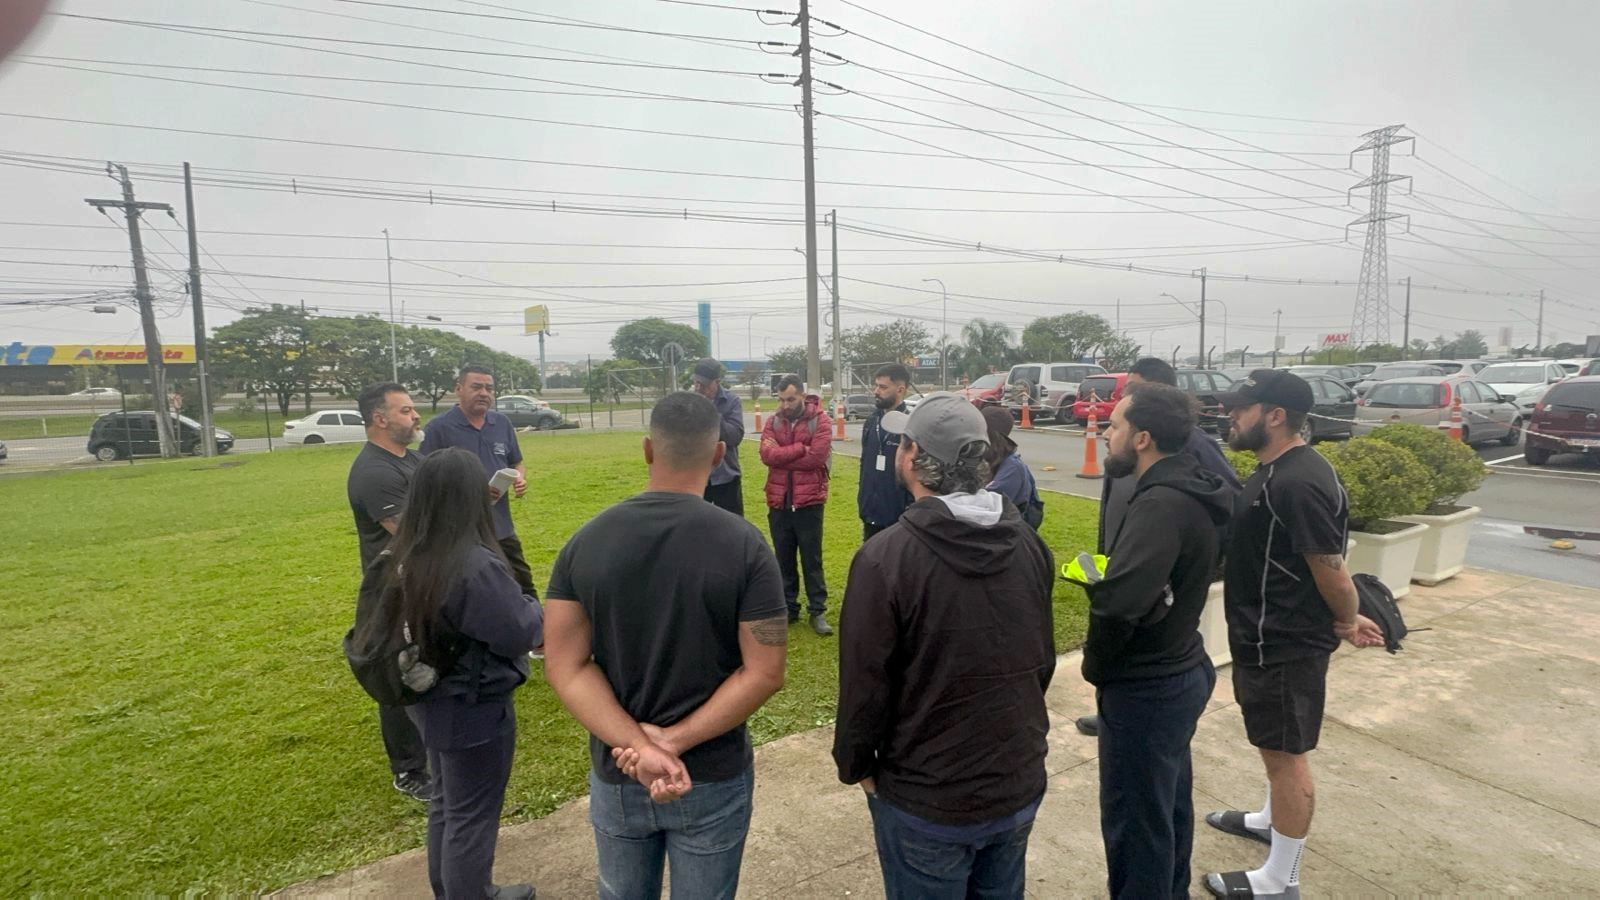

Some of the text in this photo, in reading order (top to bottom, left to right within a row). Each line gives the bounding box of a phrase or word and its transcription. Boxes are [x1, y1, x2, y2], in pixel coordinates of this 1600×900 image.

[1323, 333, 1349, 346] MAX
[0, 341, 184, 366] to Atacadta
